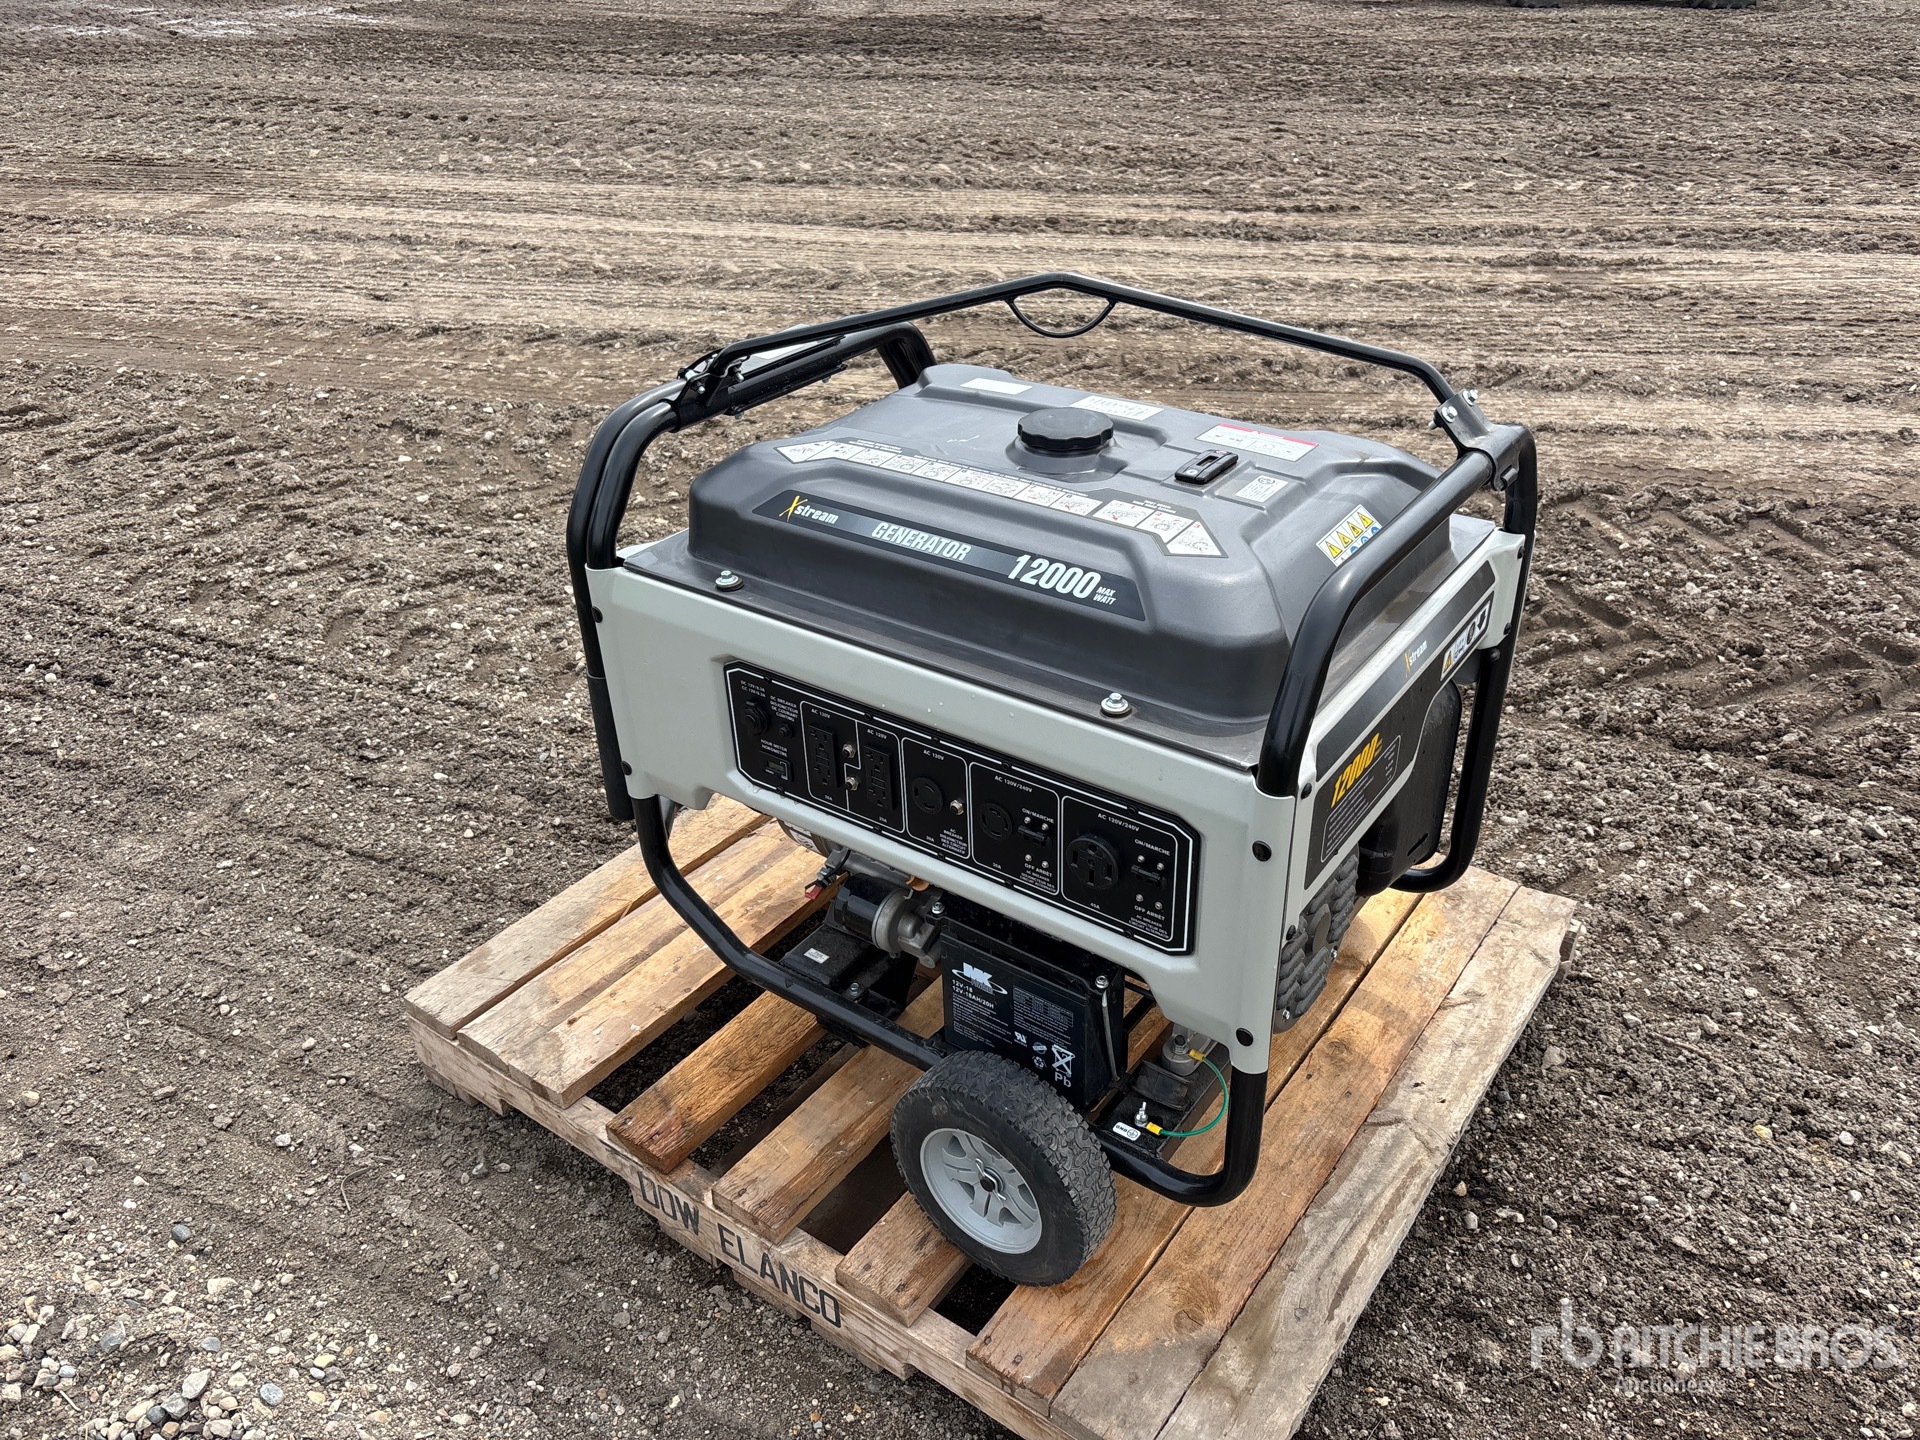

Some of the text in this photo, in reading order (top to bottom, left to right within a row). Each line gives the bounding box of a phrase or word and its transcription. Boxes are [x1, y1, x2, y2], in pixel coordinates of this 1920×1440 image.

[779, 495, 839, 525] Xstream
[871, 521, 972, 561] GENERATOR
[1007, 553, 1102, 600] 12000
[1093, 593, 1117, 606] WATT
[1096, 586, 1116, 597] MAX
[819, 711, 831, 719] 120V
[875, 731, 888, 740] 120V
[773, 743, 788, 753] METER
[932, 752, 945, 761] 120V
[1331, 732, 1379, 808] 12000
[994, 775, 1033, 793] AC 120V/240V
[1021, 807, 1054, 823] ON/MARCHE
[1097, 812, 1140, 832] AC 120V/240V
[1134, 839, 1170, 856] ON/MARCHE
[1024, 862, 1035, 870] OFF
[1134, 905, 1146, 913] OFF
[963, 962, 993, 988] MK
[952, 979, 973, 992] 12V-18
[1055, 1071, 1072, 1088] Pb
[637, 1171, 841, 1328] DOW ELANCO
